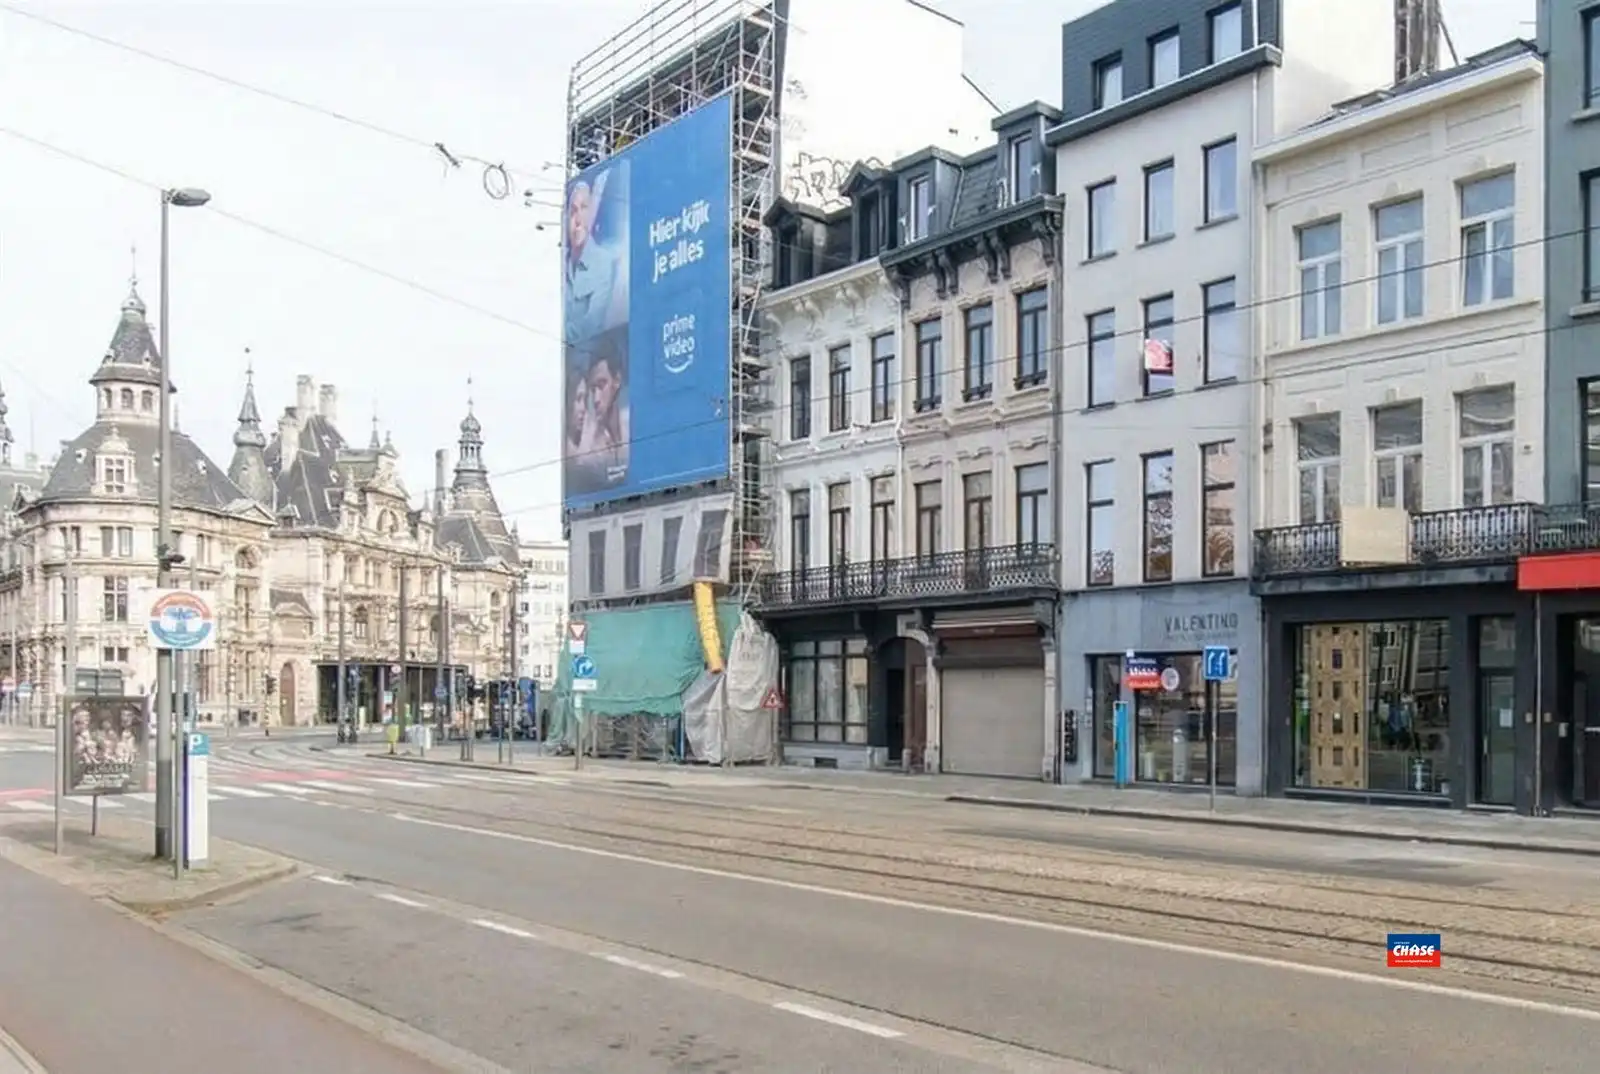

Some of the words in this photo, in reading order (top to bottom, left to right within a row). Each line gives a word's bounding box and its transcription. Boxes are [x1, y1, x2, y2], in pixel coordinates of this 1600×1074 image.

[649, 217, 681, 248] Hier
[682, 199, 710, 234] kijk
[652, 248, 668, 284] je
[669, 239, 704, 272] alles
[663, 313, 696, 341] prime
[663, 336, 696, 359] video
[1164, 612, 1239, 633] VALENTINO
